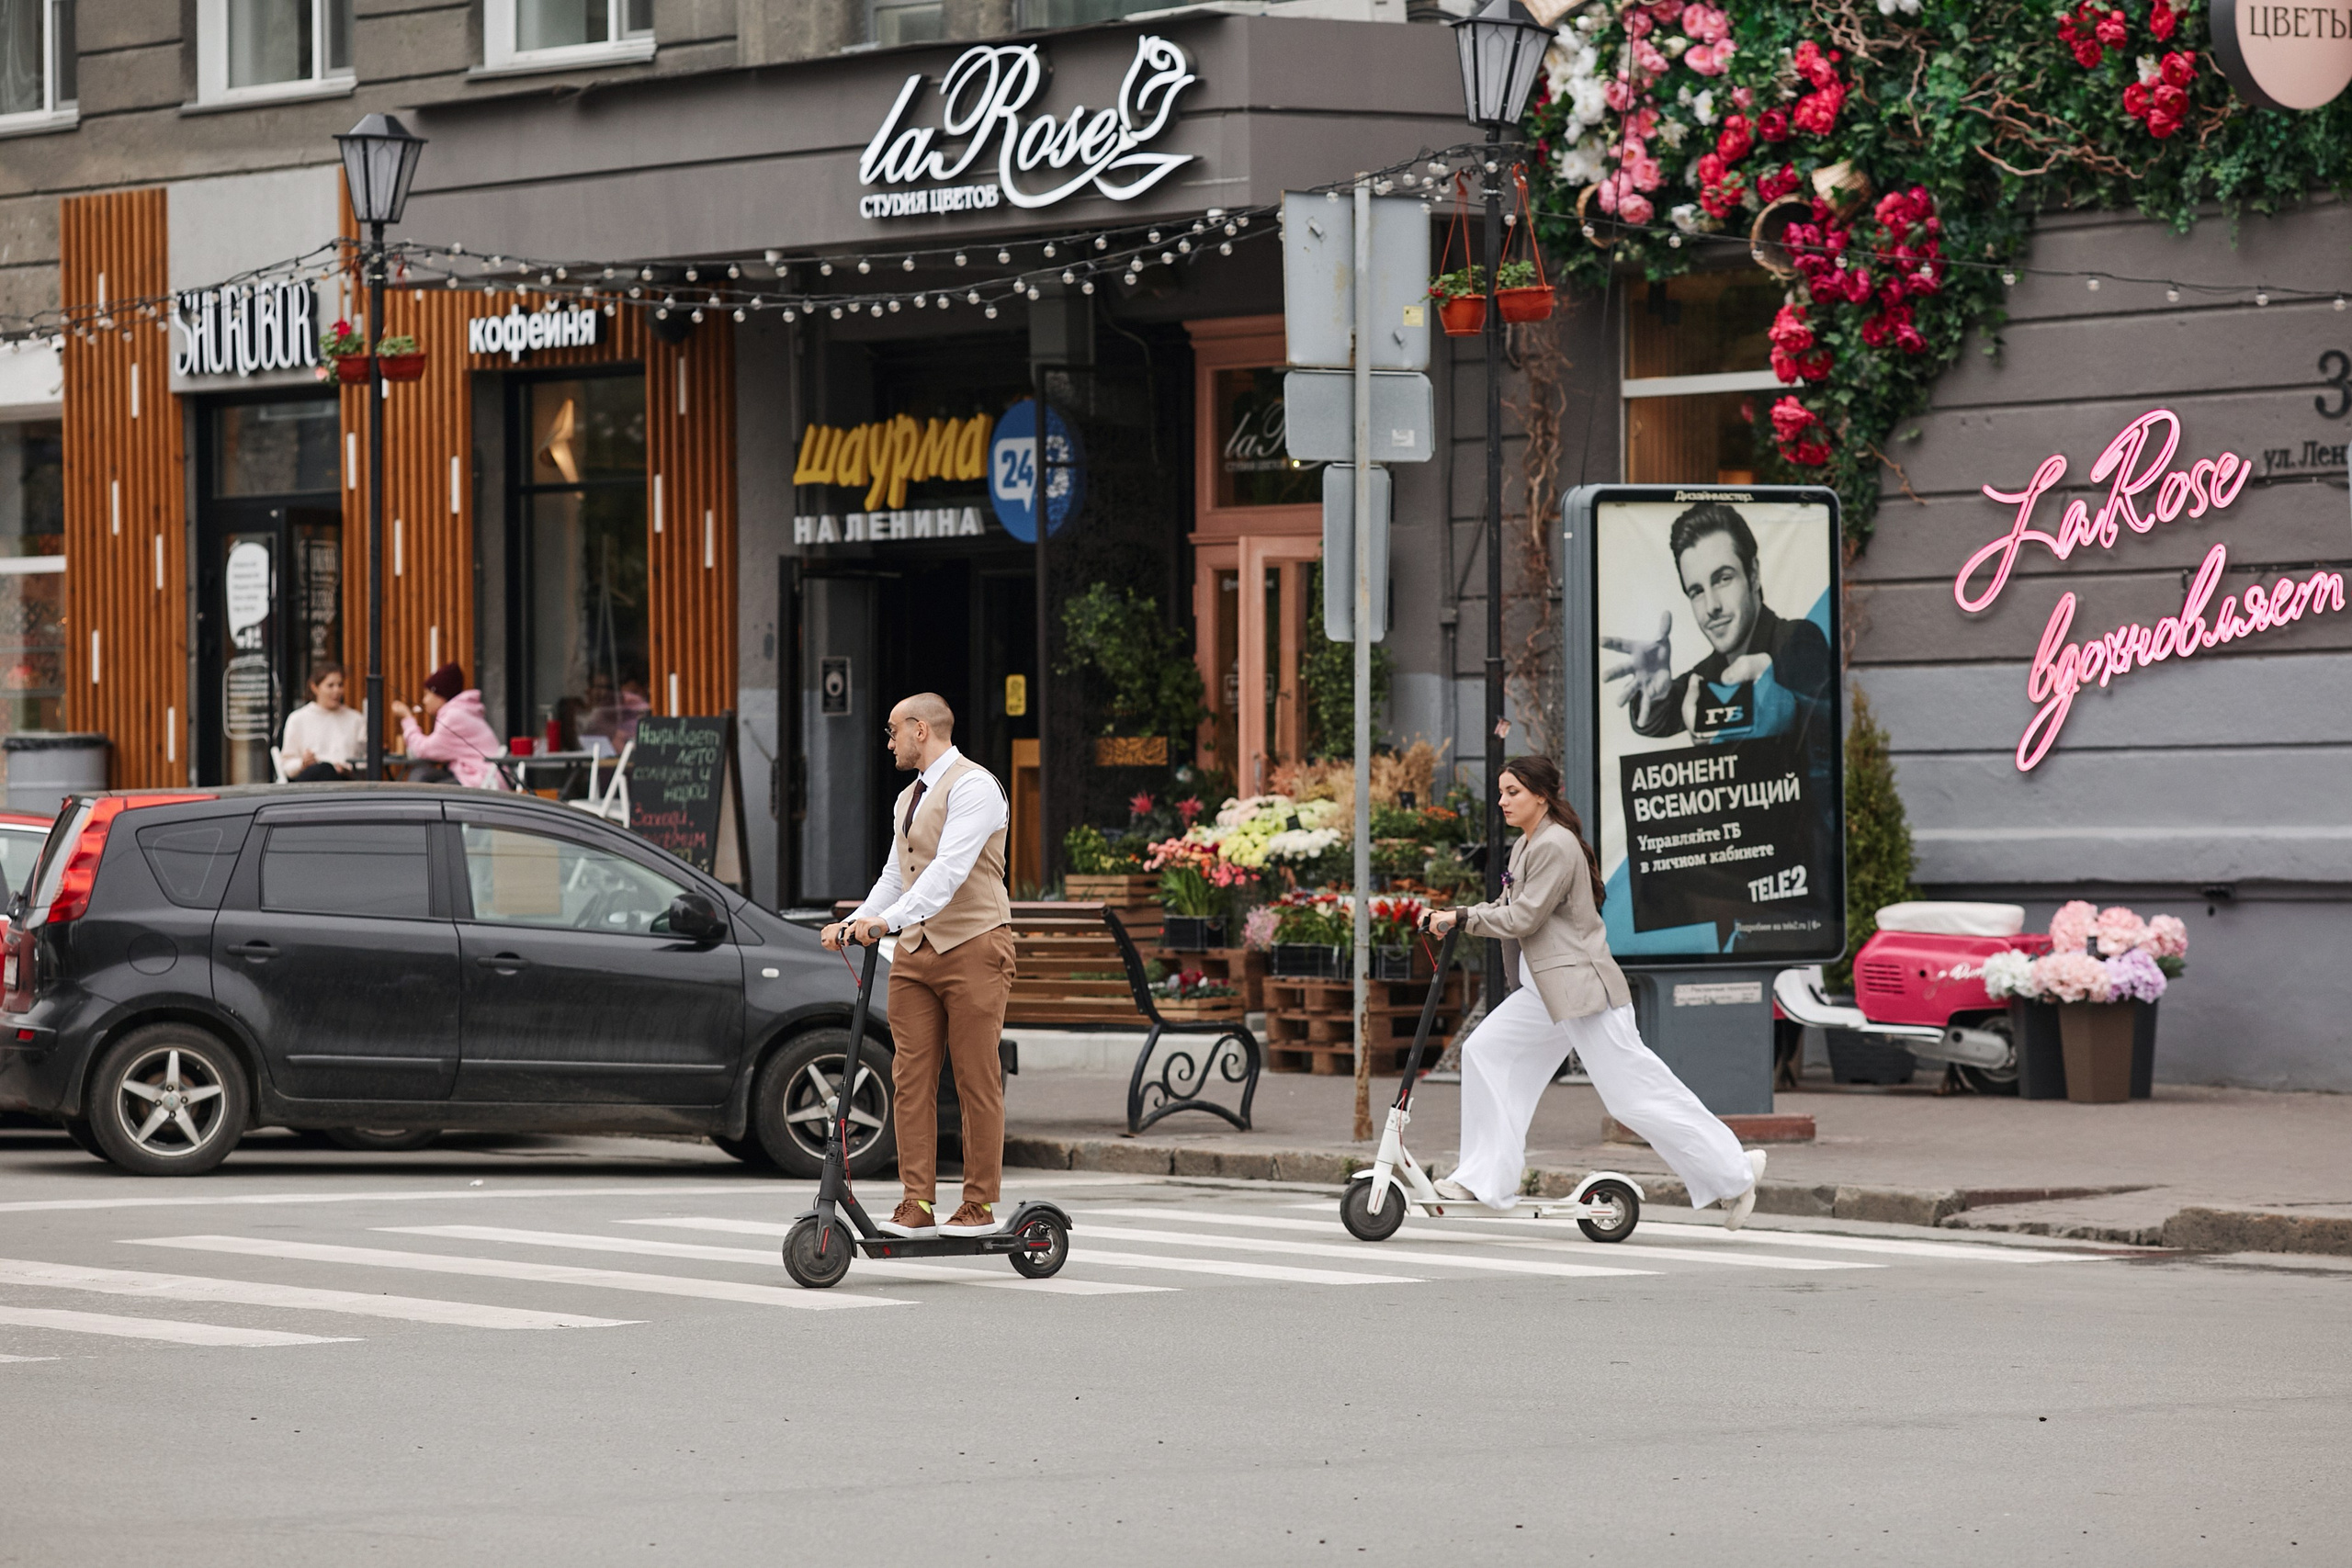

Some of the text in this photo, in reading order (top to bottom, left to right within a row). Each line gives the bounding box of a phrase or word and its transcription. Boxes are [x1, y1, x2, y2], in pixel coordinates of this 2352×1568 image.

[2249, 6, 2352, 41] ЦВЕТЫ
[930, 185, 1000, 216] ЦВЕТОВ
[469, 299, 596, 363] кофейня
[793, 412, 993, 512] шаурма
[2264, 440, 2348, 476] ул. Лен
[794, 506, 986, 545] НА ЛЕНИНА
[2015, 543, 2346, 772] вдохновляет
[1705, 705, 1744, 725] ГБ
[1631, 754, 1738, 792] АБОНЕНТ
[1634, 772, 1801, 822] ВСЕМОГУЩИЙ
[1636, 822, 1742, 853] Управляйте ГБ
[1640, 843, 1775, 874] в личном кабинете
[1747, 864, 1808, 902] TELE2
